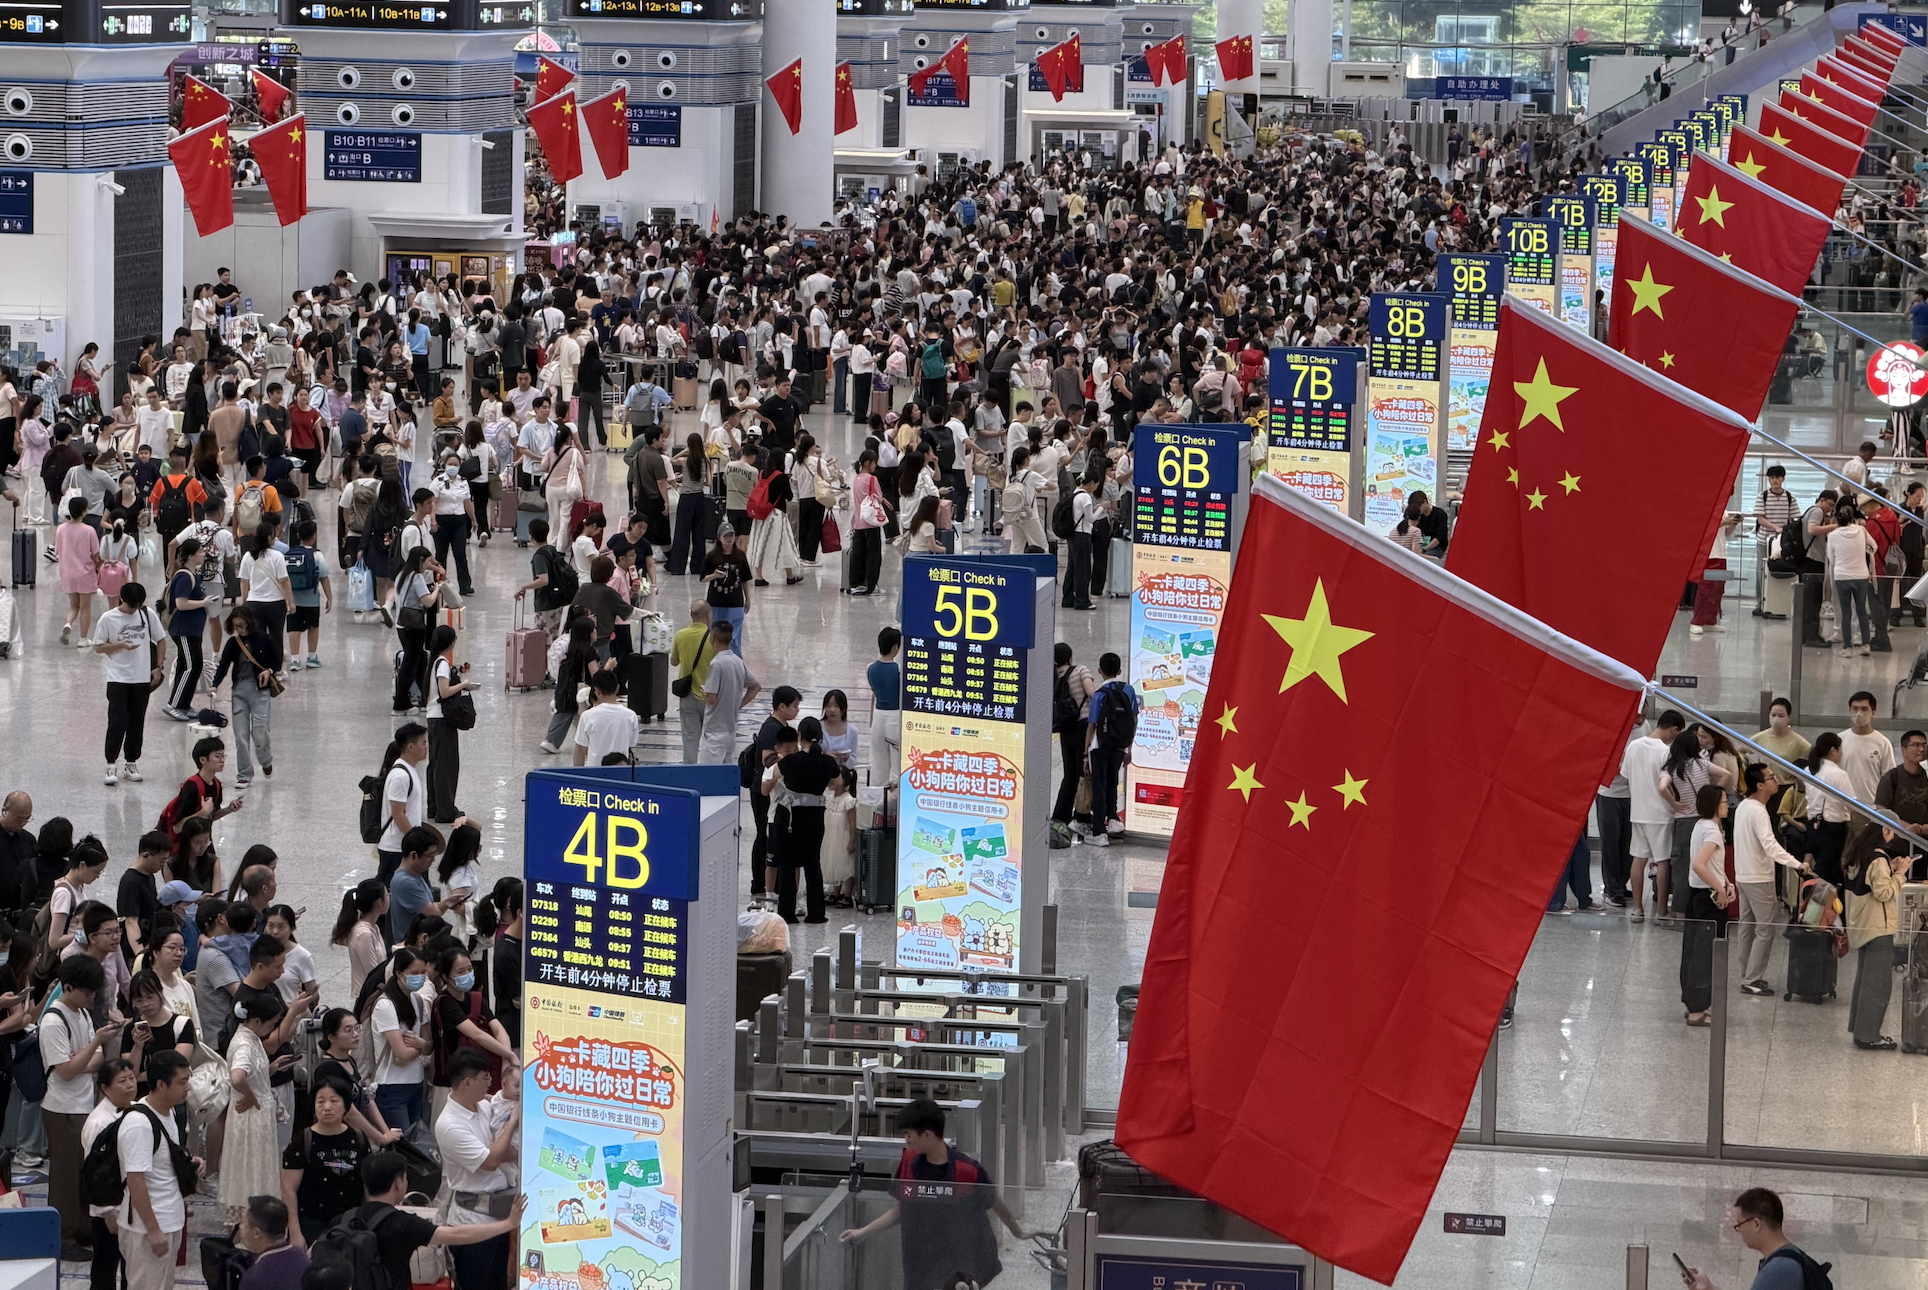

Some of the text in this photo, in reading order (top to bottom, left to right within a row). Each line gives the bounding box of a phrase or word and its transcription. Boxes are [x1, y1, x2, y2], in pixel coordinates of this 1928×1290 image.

[326, 7, 420, 19] 10A-11A 10B-11B
[602, 1, 680, 12] 12A-13A 12B-13B
[0, 18, 24, 30] -9B
[198, 46, 254, 60] 创新之城
[1448, 80, 1499, 89] 自助办理处
[632, 123, 639, 132] B
[363, 154, 371, 164] B
[1583, 183, 1617, 203] 12B
[1547, 204, 1585, 226] 11B
[1507, 228, 1548, 252] 10B
[1453, 265, 1487, 293] 9B
[1405, 299, 1423, 307] Check
[1388, 307, 1425, 337] 8B
[1286, 354, 1308, 364] 检票口
[1310, 356, 1330, 365] Check
[1290, 364, 1333, 401] 7B
[1374, 409, 1434, 422] 小狗陪你过日常
[1154, 432, 1216, 446] 检票口 Check in
[1276, 437, 1343, 450] 开车前4分钟停止检票
[727, 466, 752, 481] CAMPING
[1158, 445, 1210, 488] 6B
[1283, 474, 1332, 486] 一卡藏四季
[1142, 533, 1222, 549] 开车前4分钟停止检票
[929, 567, 1006, 586] 检票口 Check in
[1150, 574, 1209, 592] 一卡藏四季
[1140, 588, 1222, 610] 小狗陪你过日常
[934, 584, 999, 641] 5B
[911, 638, 1013, 656] 车次 终到站 开点 状态
[907, 650, 928, 659] D7318
[967, 656, 985, 665] 08:50
[994, 658, 1019, 669] 正在候车
[907, 662, 928, 670] D2290
[966, 668, 984, 676] 08:55
[994, 670, 1019, 681] 正在候车
[907, 673, 1018, 693] D7364 汕头 09:37 正在候车
[906, 685, 1018, 704] G6579 香港西九龙 09:51 正在候车
[913, 696, 1015, 720] 开车前4分钟停止检票
[923, 752, 998, 776] 一卡藏四季
[911, 769, 1015, 798] 小狗陪你过日常
[559, 786, 660, 814] 检票口 Check in
[920, 798, 1004, 815] 中国银行线条小狗主题信用卡
[563, 811, 650, 890] 4B
[536, 882, 670, 911] 车次 终到站 开点 状态
[531, 899, 677, 929] D7318 汕尾 08:50 正在候车
[531, 915, 558, 927] D2290
[609, 926, 632, 937] 08:55
[643, 930, 677, 945] 正在候车
[912, 926, 942, 938] 产品权益
[531, 931, 676, 961] D7364 汕头 09:37 正在候车
[530, 947, 676, 978] G6579 香港西九龙 09:51 正在候车
[539, 963, 672, 998] 开车前4分钟停止检票
[553, 1040, 650, 1075] 一卡藏四季
[537, 1062, 672, 1105] 小狗陪你过日常
[549, 1102, 658, 1129] 中国银行线条小狗主题信用卡
[1466, 1218, 1502, 1228] 禁止攀爬
